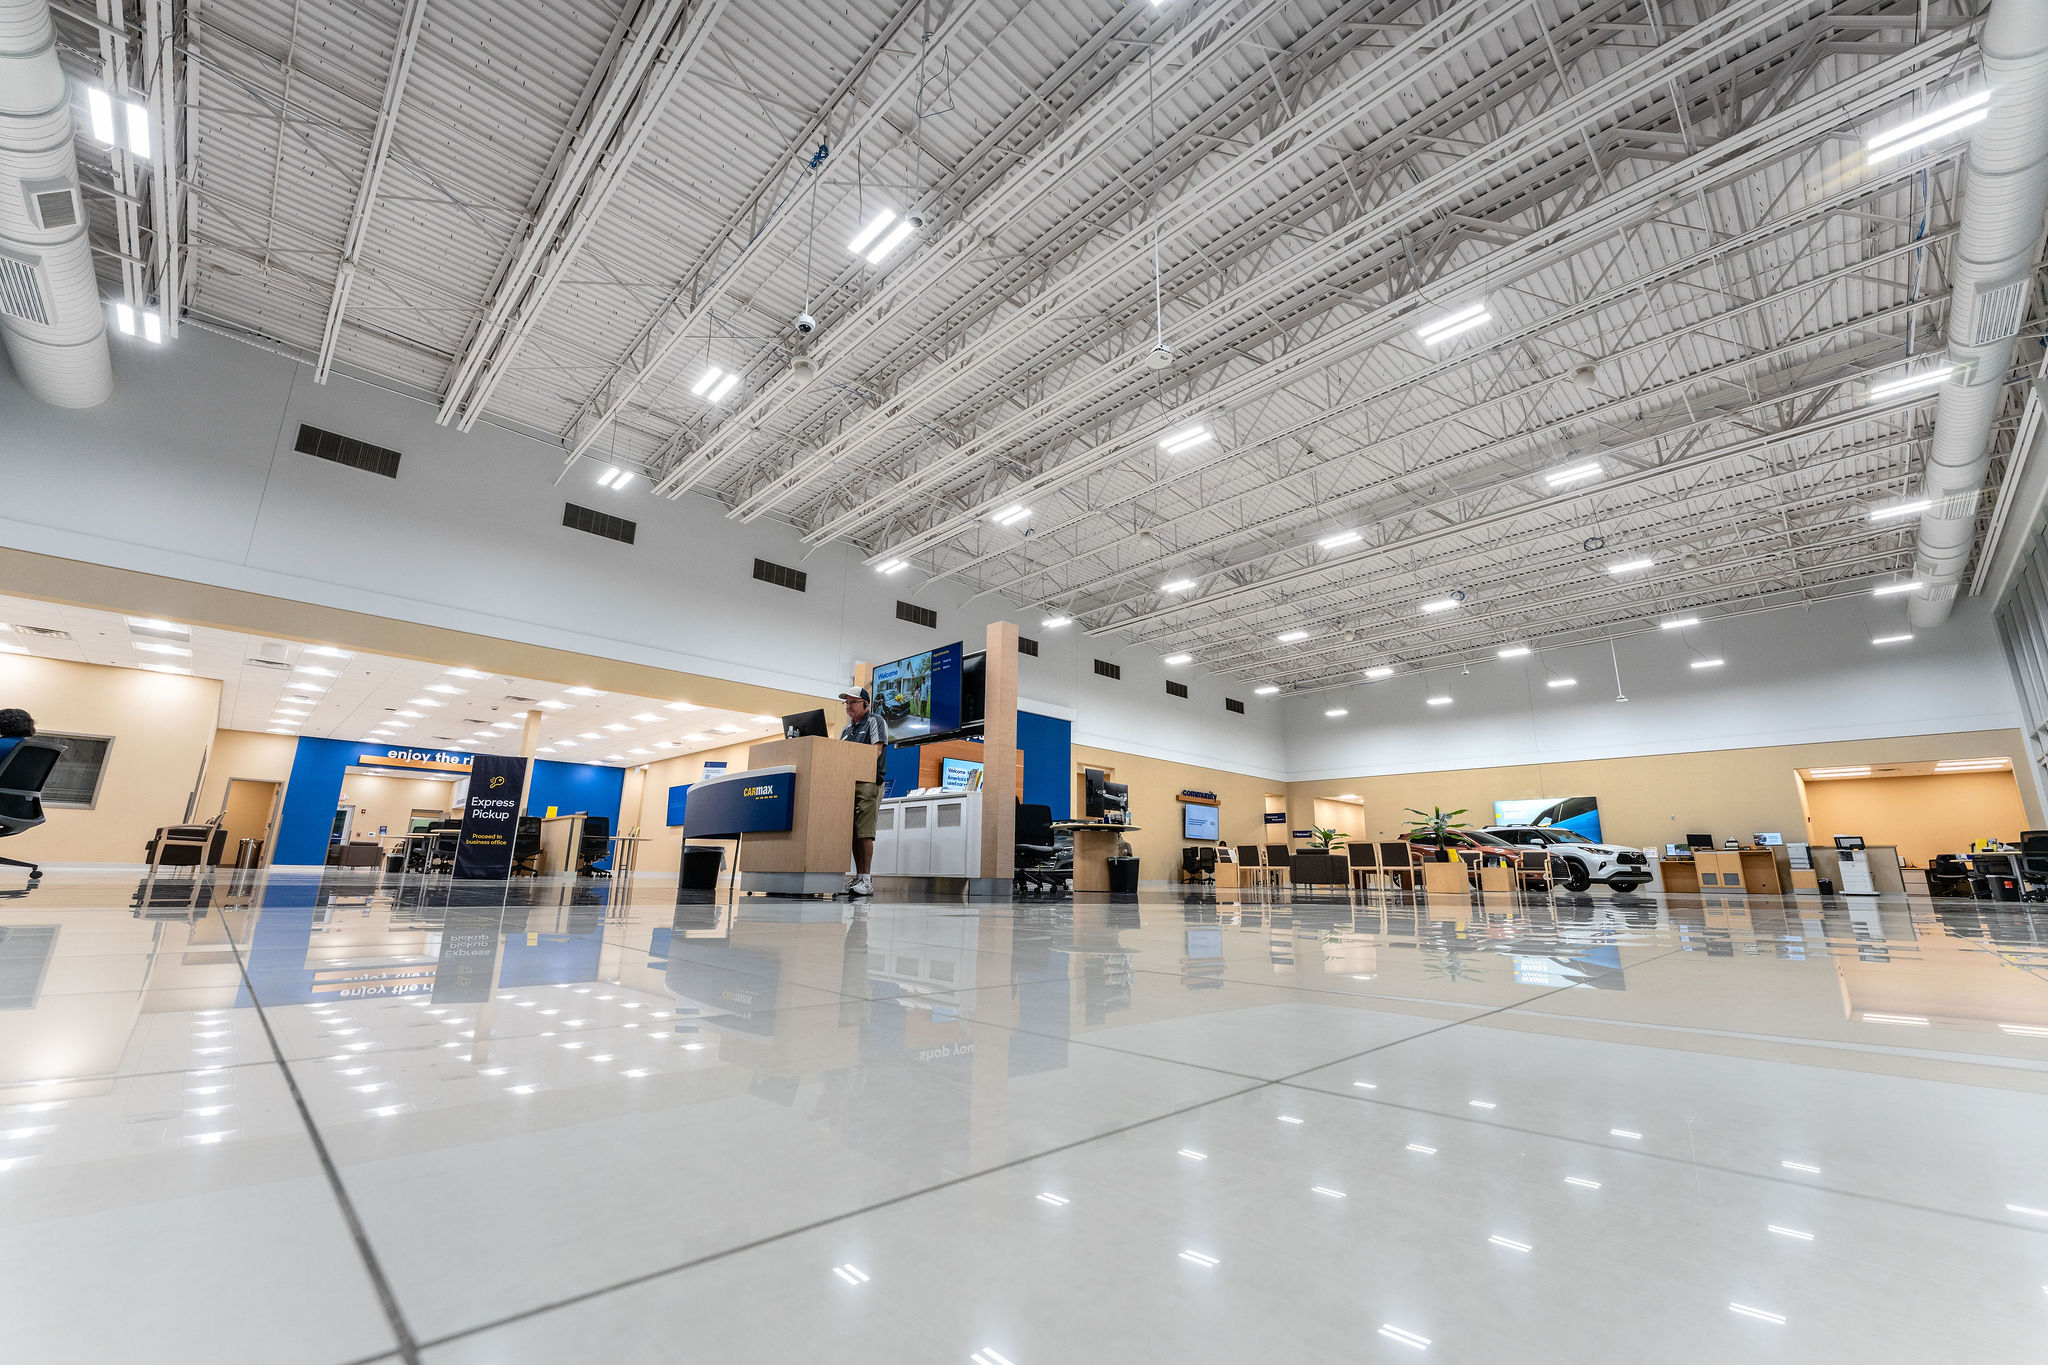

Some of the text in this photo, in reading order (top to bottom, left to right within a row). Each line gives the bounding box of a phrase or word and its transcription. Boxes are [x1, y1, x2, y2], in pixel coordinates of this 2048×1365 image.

[878, 670, 899, 680] Welcome
[388, 749, 475, 766] enjoy the ri
[743, 784, 773, 797] CARmax
[1182, 789, 1217, 803] community
[471, 796, 515, 809] Express
[472, 809, 510, 821] Pickup
